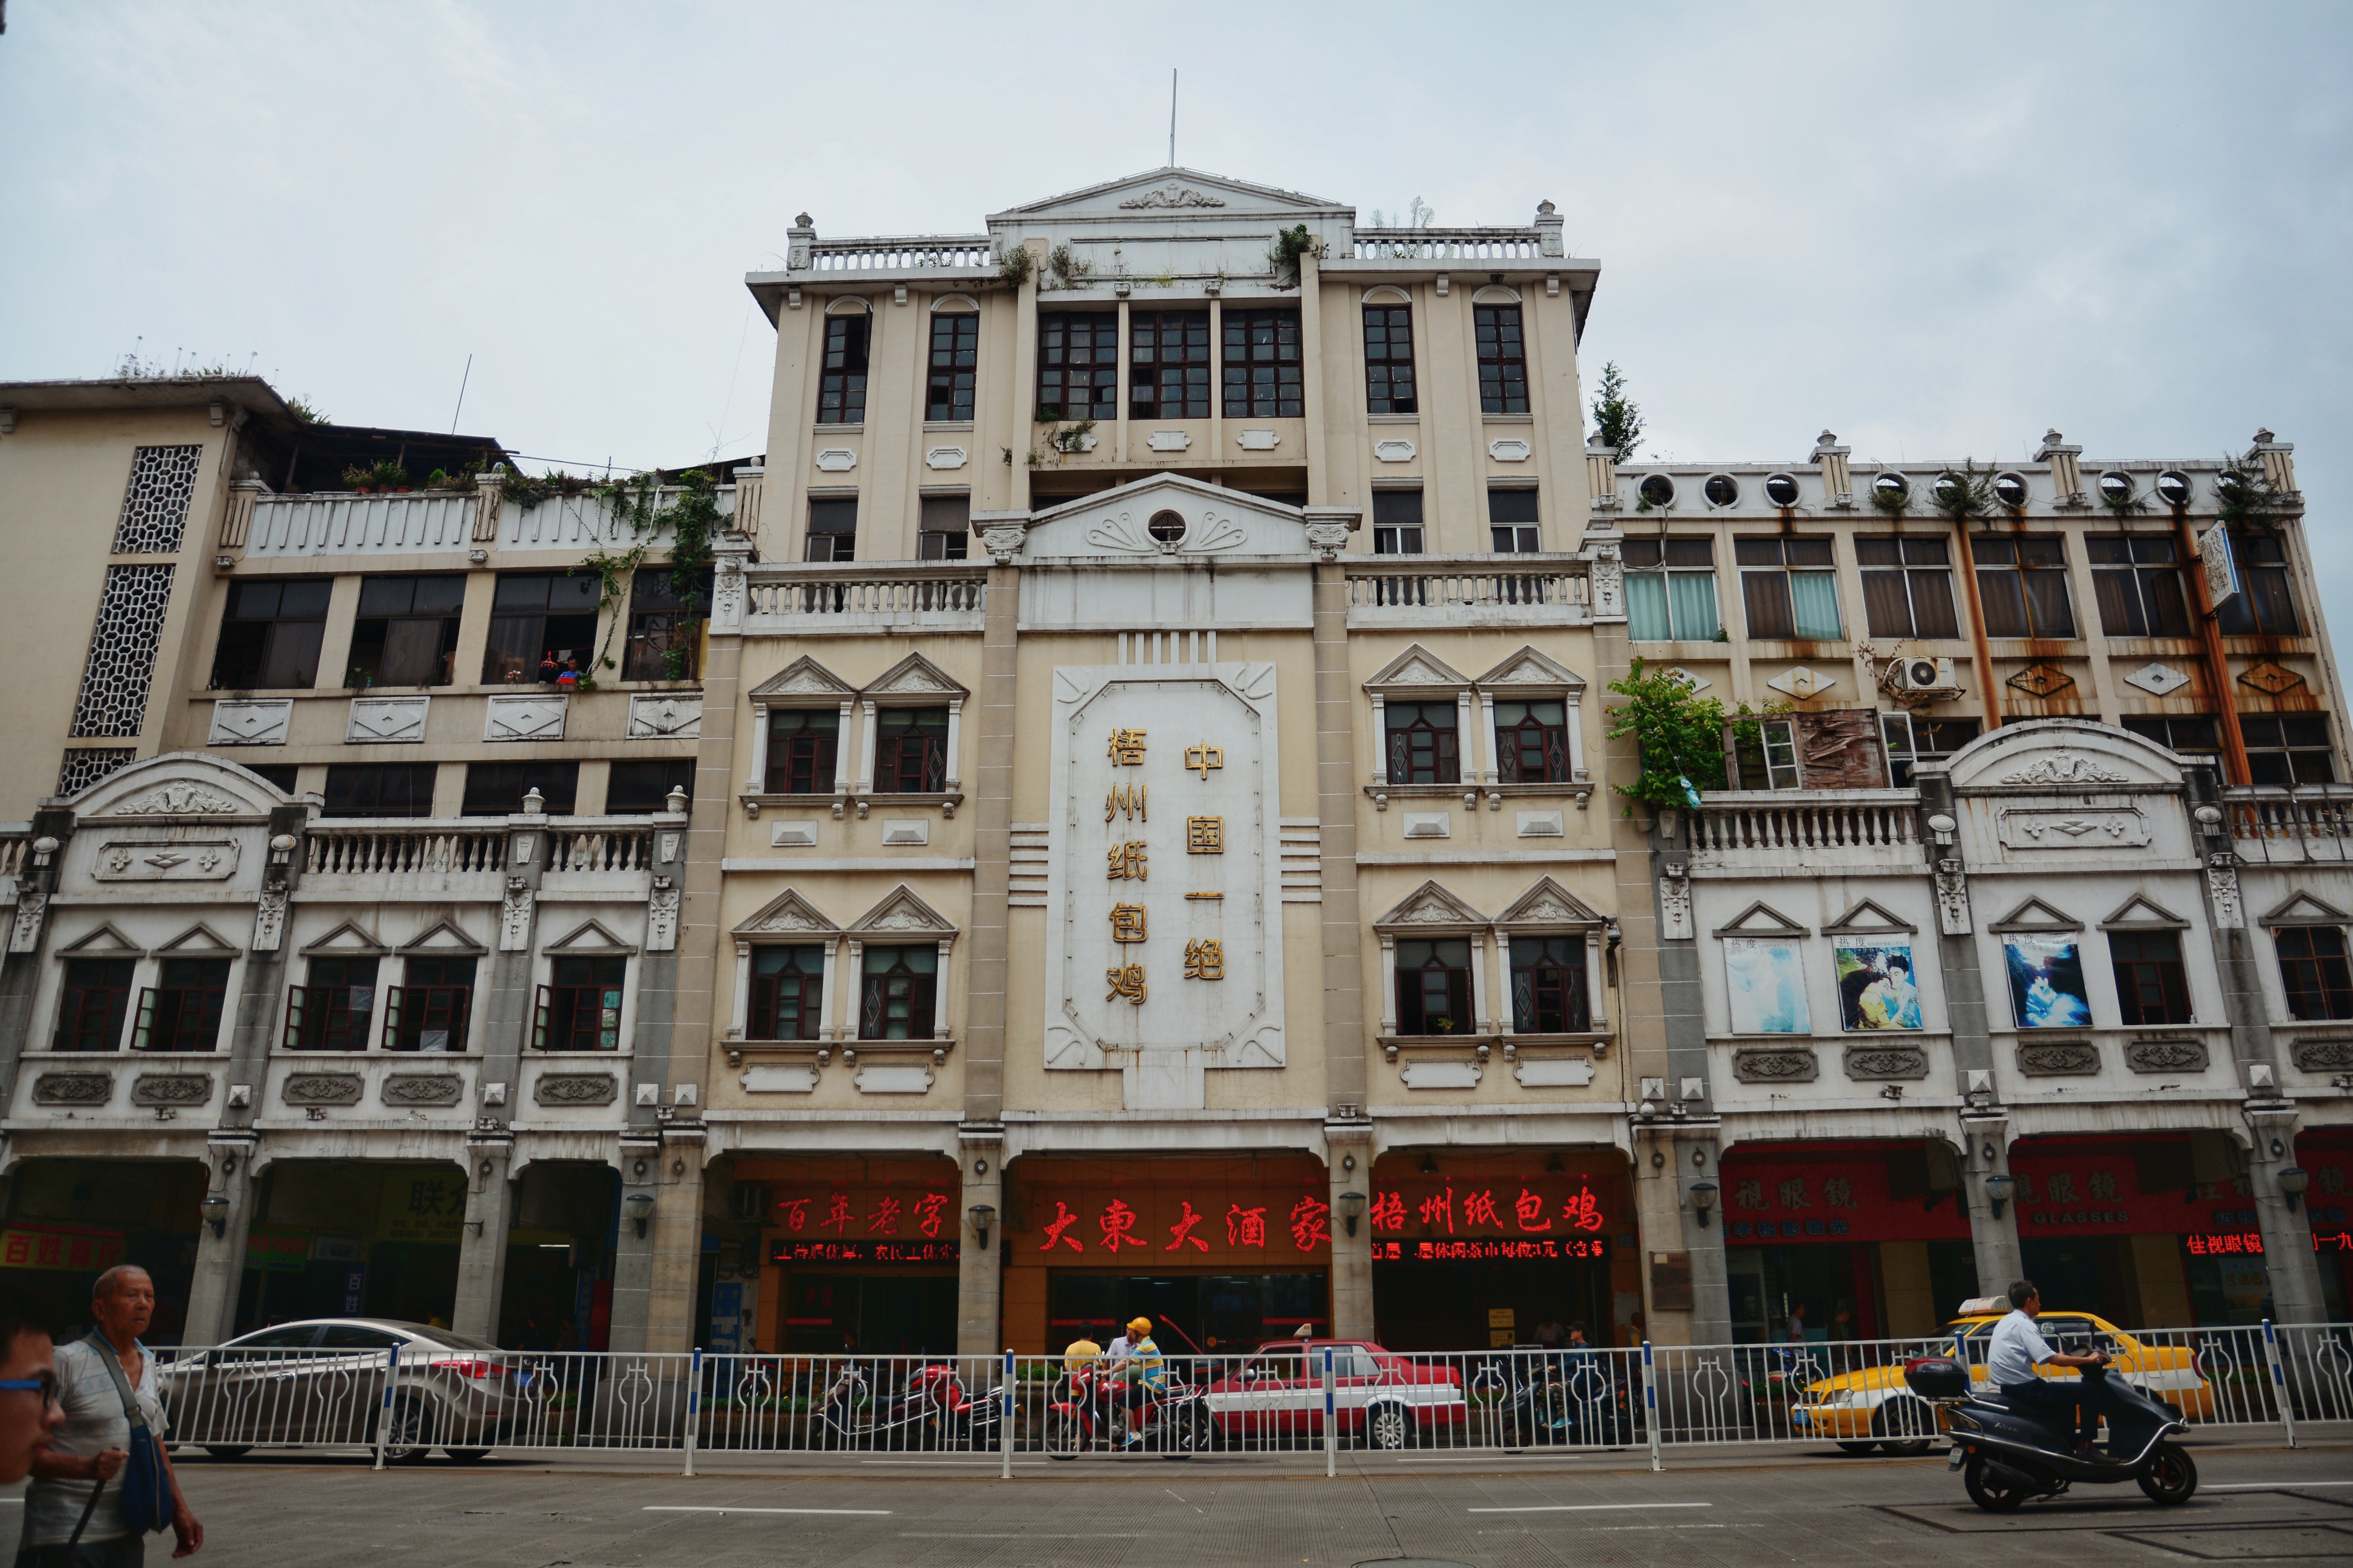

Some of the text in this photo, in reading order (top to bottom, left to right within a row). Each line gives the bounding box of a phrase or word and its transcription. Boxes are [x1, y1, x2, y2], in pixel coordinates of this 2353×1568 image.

[1105, 727, 1148, 1004] 梧州纸包鸡
[1184, 740, 1224, 980] 中国一绝
[1731, 938, 1757, 949] 热度
[1838, 936, 1866, 947] 热度
[2008, 934, 2035, 945] 热度
[778, 1191, 949, 1240] 百年老字
[1040, 1195, 1332, 1253] 大東大酒家
[1370, 1186, 1603, 1235] 梧州纸包鸡
[2032, 1212, 2129, 1224] GLASSES
[5, 1234, 123, 1268] 百姓舞厅
[345, 1273, 362, 1313] 百姓
[578, 1272, 593, 1345] 专业维修手机
